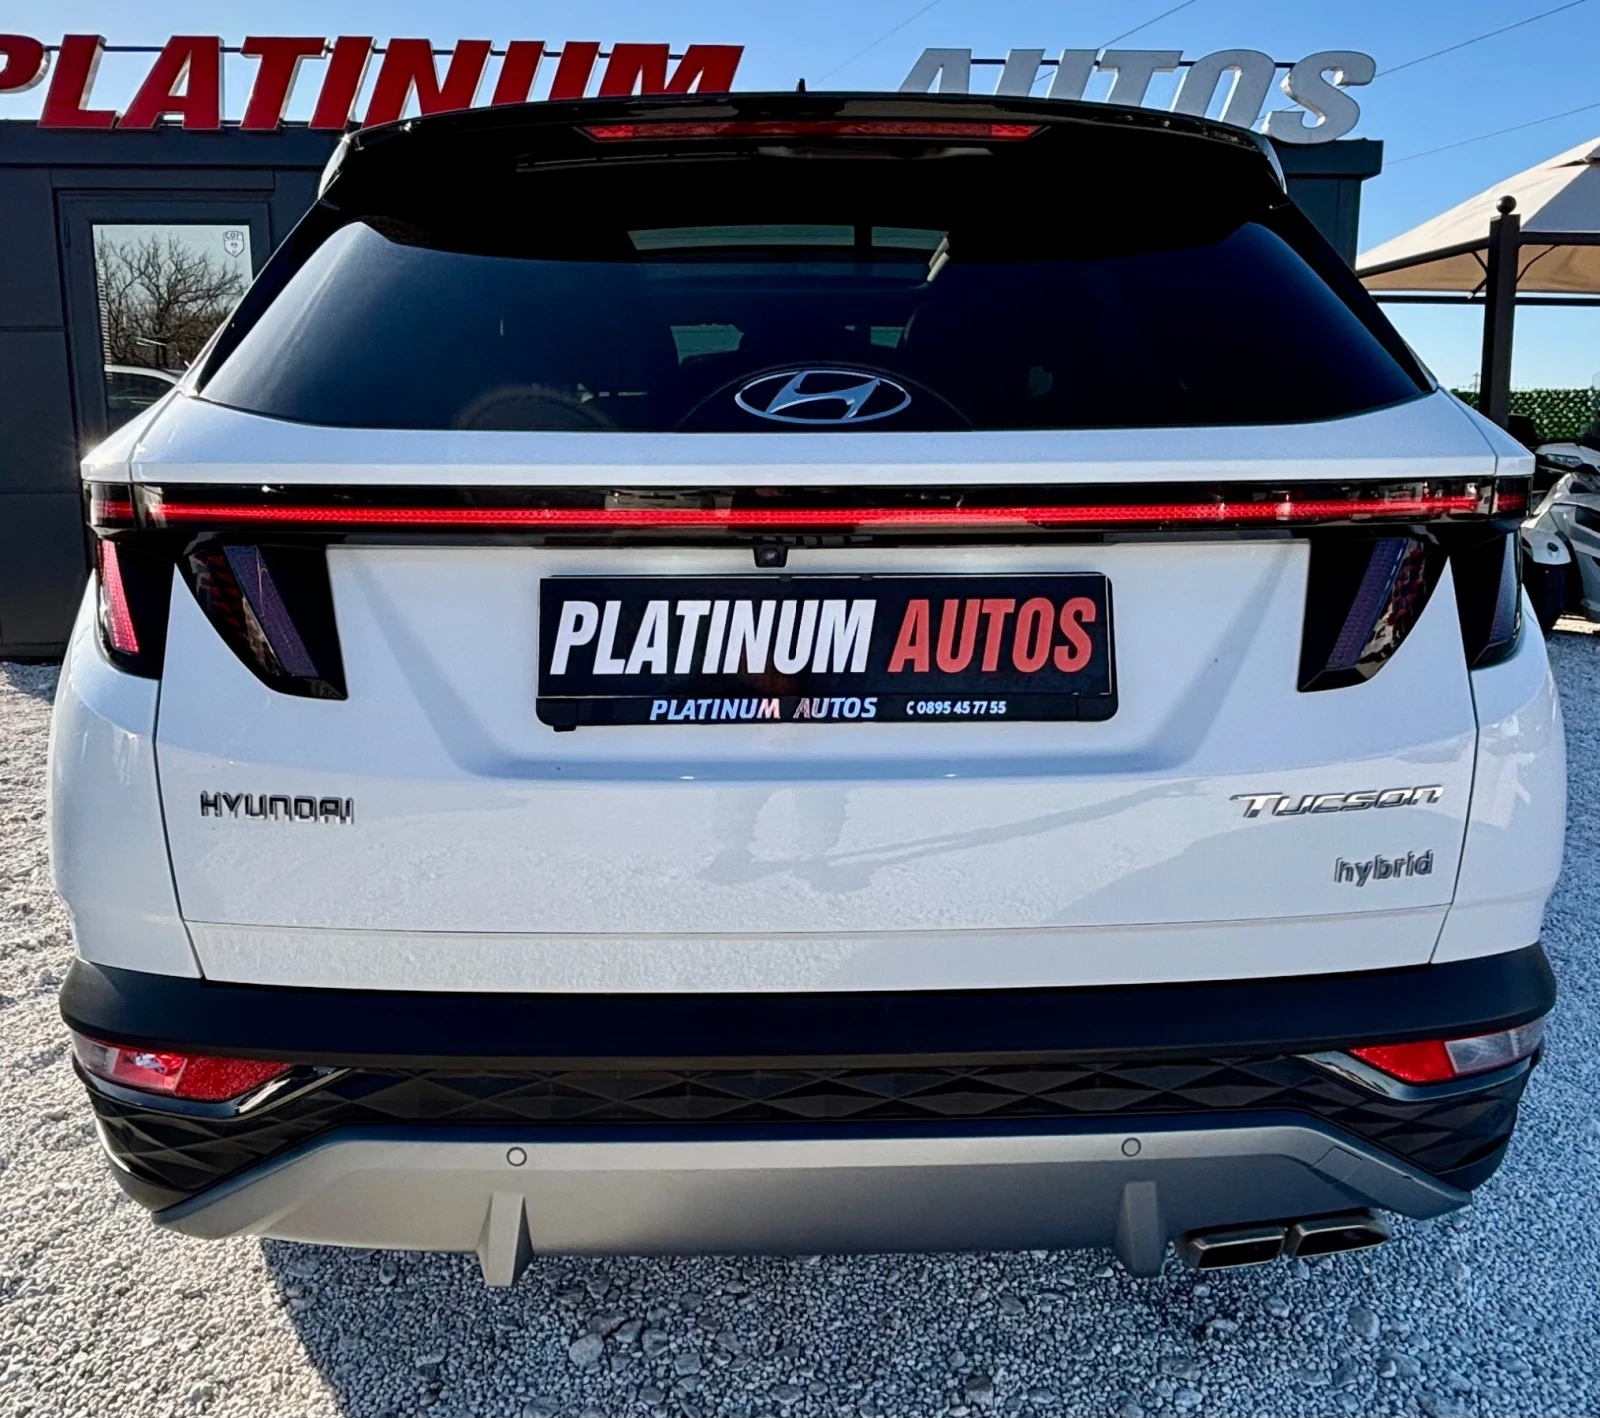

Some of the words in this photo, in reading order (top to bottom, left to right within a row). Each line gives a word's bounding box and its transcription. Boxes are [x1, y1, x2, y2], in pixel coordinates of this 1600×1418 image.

[550, 599, 877, 675] PLATINUM
[887, 596, 1097, 674] AUTOS
[649, 698, 781, 720] PLATINUM
[793, 697, 878, 719] AUTOS
[916, 700, 952, 715] 0895
[953, 700, 971, 715] 45
[972, 700, 989, 715] 77
[989, 700, 1007, 715] 55
[200, 790, 355, 825] HYUNDAI
[1333, 849, 1435, 887] hybrid
